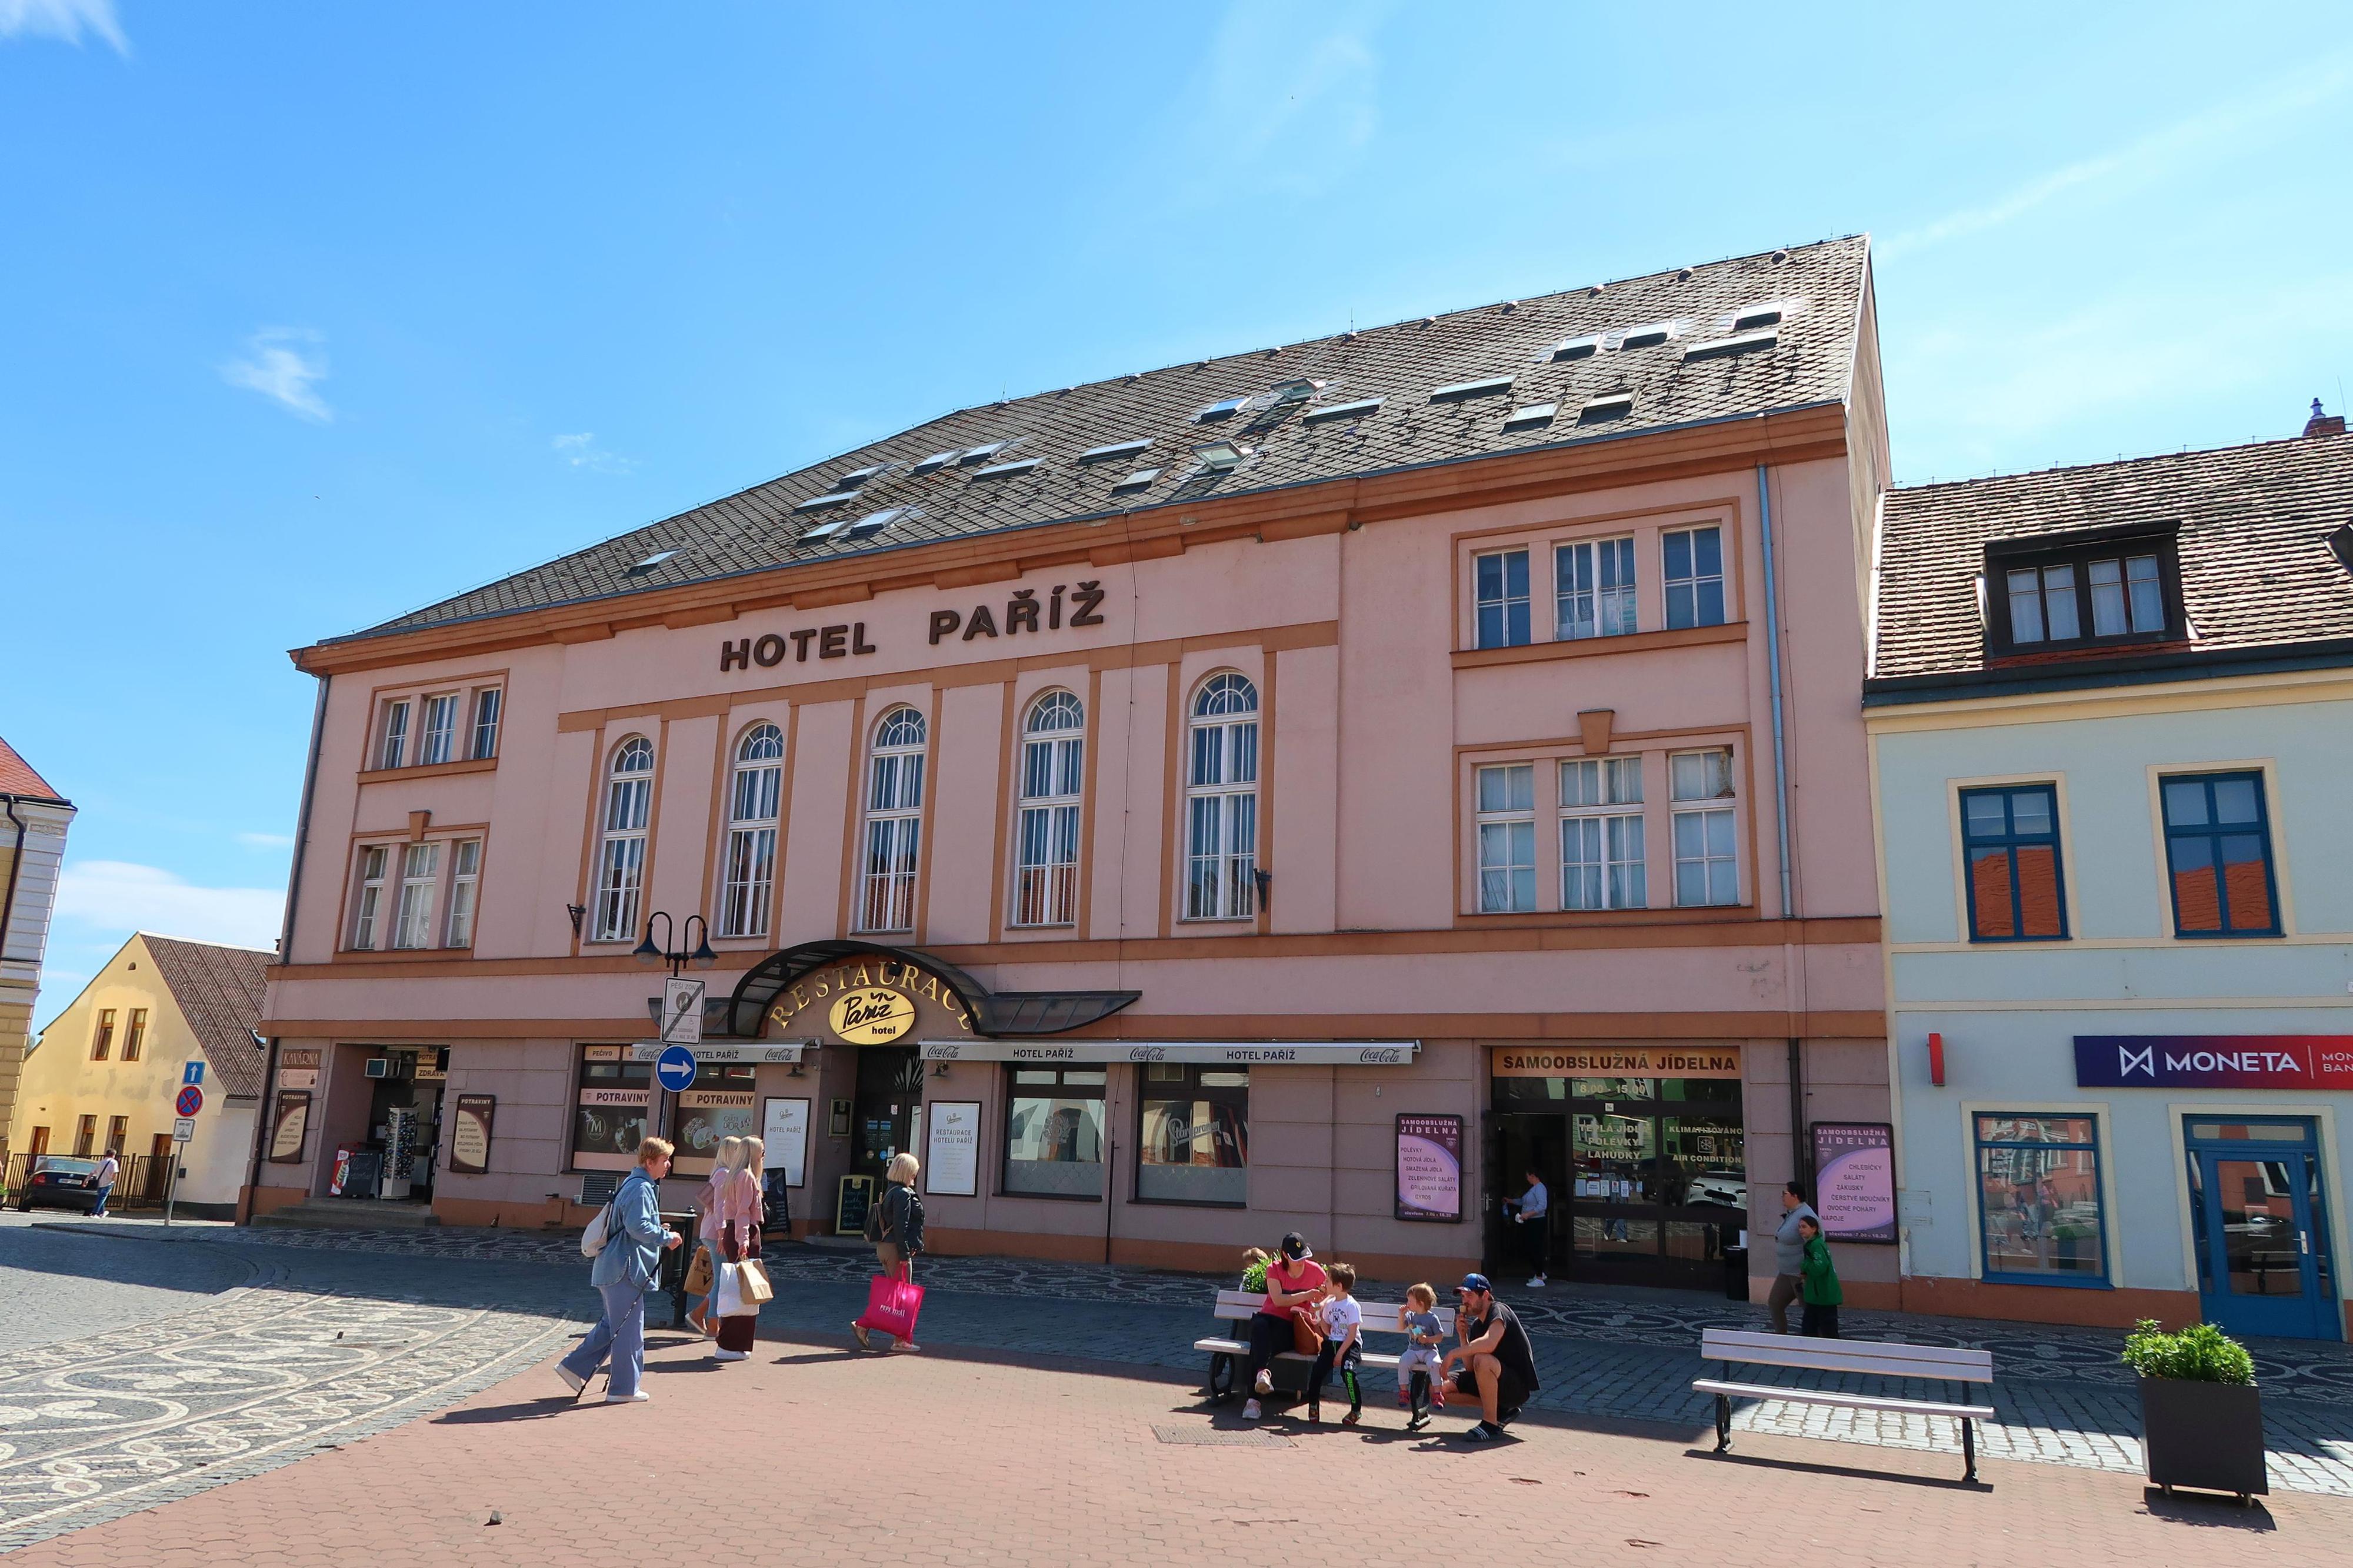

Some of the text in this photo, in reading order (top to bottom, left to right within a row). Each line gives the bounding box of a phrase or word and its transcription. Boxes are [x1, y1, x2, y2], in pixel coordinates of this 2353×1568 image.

[720, 580, 1105, 672] HOTEL PAŘÍŽ
[769, 960, 978, 1030] RESTAURACE
[872, 1026, 896, 1035] hotel
[283, 1051, 319, 1065] KAVÁRNA
[716, 1049, 739, 1059] PAŘÍŽ
[1013, 1047, 1074, 1058] HOTEL PAŘÍŽ
[1227, 1049, 1296, 1060] HOTEL PAŘÍŽ
[1503, 1053, 1736, 1070] SAMOOBSLUŽNÁ JÍDELNA
[2164, 1051, 2302, 1072] MONETA
[596, 1092, 650, 1103] POTRAVINY
[696, 1095, 754, 1105] POTRAVINY
[786, 1125, 801, 1133] PAŘÍŽ
[1401, 1125, 1458, 1135] JÍDELNA
[1669, 1125, 1743, 1135] KLIMATIZOVÁNO
[1588, 1136, 1640, 1146] POLÉVKY
[1818, 1135, 1888, 1146] JÍDELNA
[1588, 1149, 1641, 1160] LAHŮDKY
[1689, 1155, 1742, 1163] CONDITION
